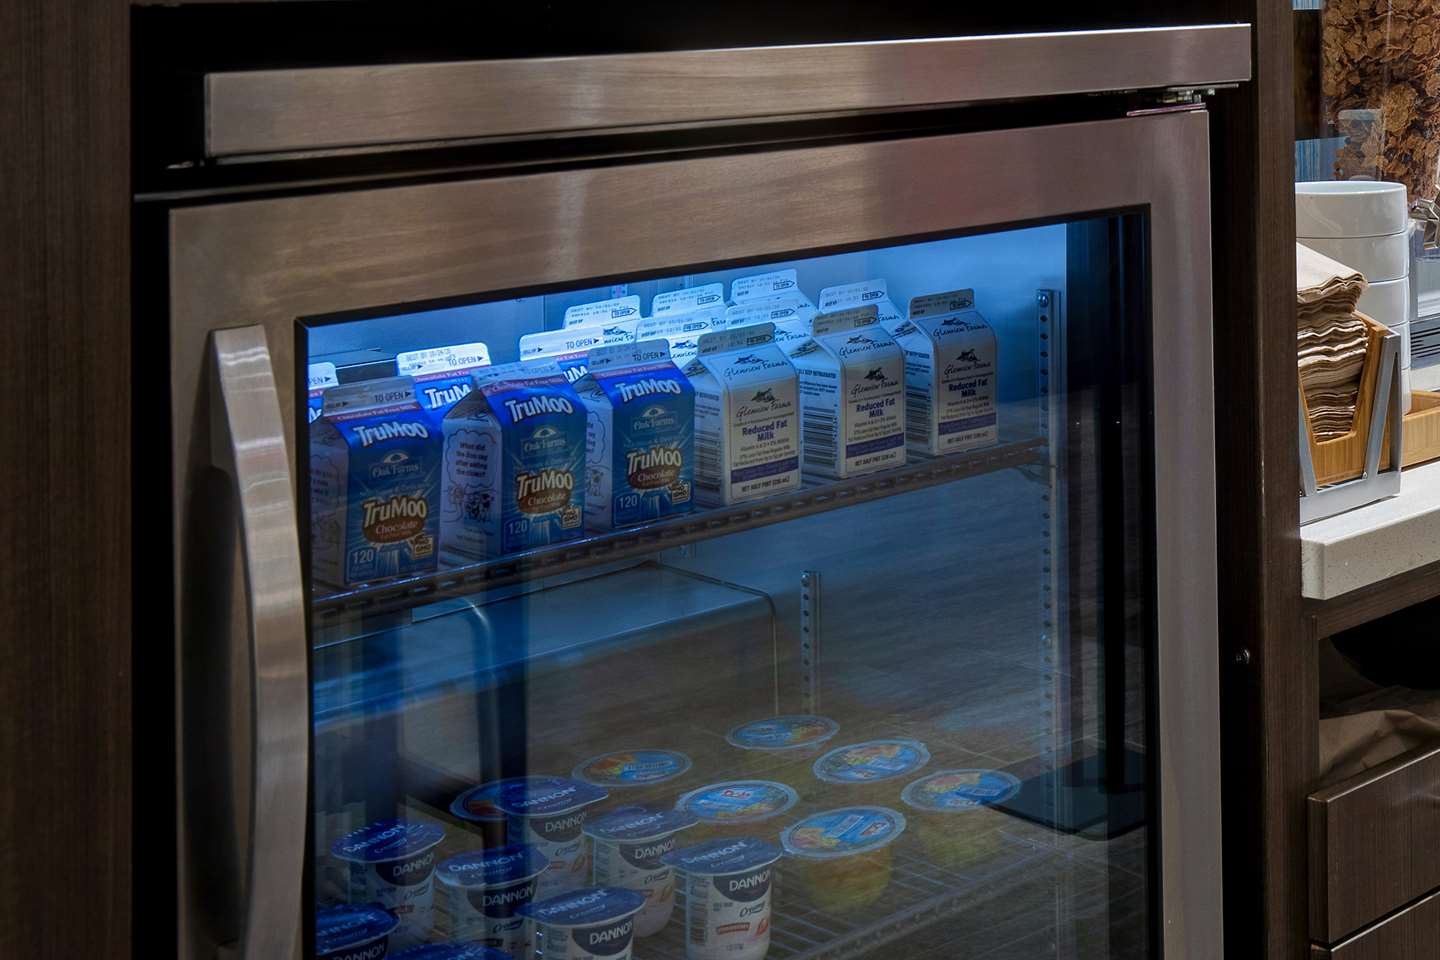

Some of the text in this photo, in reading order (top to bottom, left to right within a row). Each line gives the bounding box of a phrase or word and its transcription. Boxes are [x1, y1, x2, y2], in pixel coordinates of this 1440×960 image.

[575, 339, 593, 347] OPEN
[615, 379, 681, 403] TruMoo
[949, 378, 988, 392] Reduced Fat
[424, 383, 471, 409] TruM
[961, 389, 977, 398] Milk
[505, 395, 574, 423] TruMoo
[856, 397, 896, 412] Reduced Fat
[868, 410, 885, 419] Milk
[352, 421, 429, 448] TruMoo
[742, 420, 788, 437] Reduced Fat
[757, 433, 775, 442] Milk
[626, 448, 682, 476] TruMoo
[517, 472, 574, 501] TruMoo
[619, 496, 638, 509] 120
[363, 496, 427, 528] TruMoo
[507, 520, 528, 535] 120
[352, 548, 374, 564] 120
[481, 884, 534, 907] DANNON
